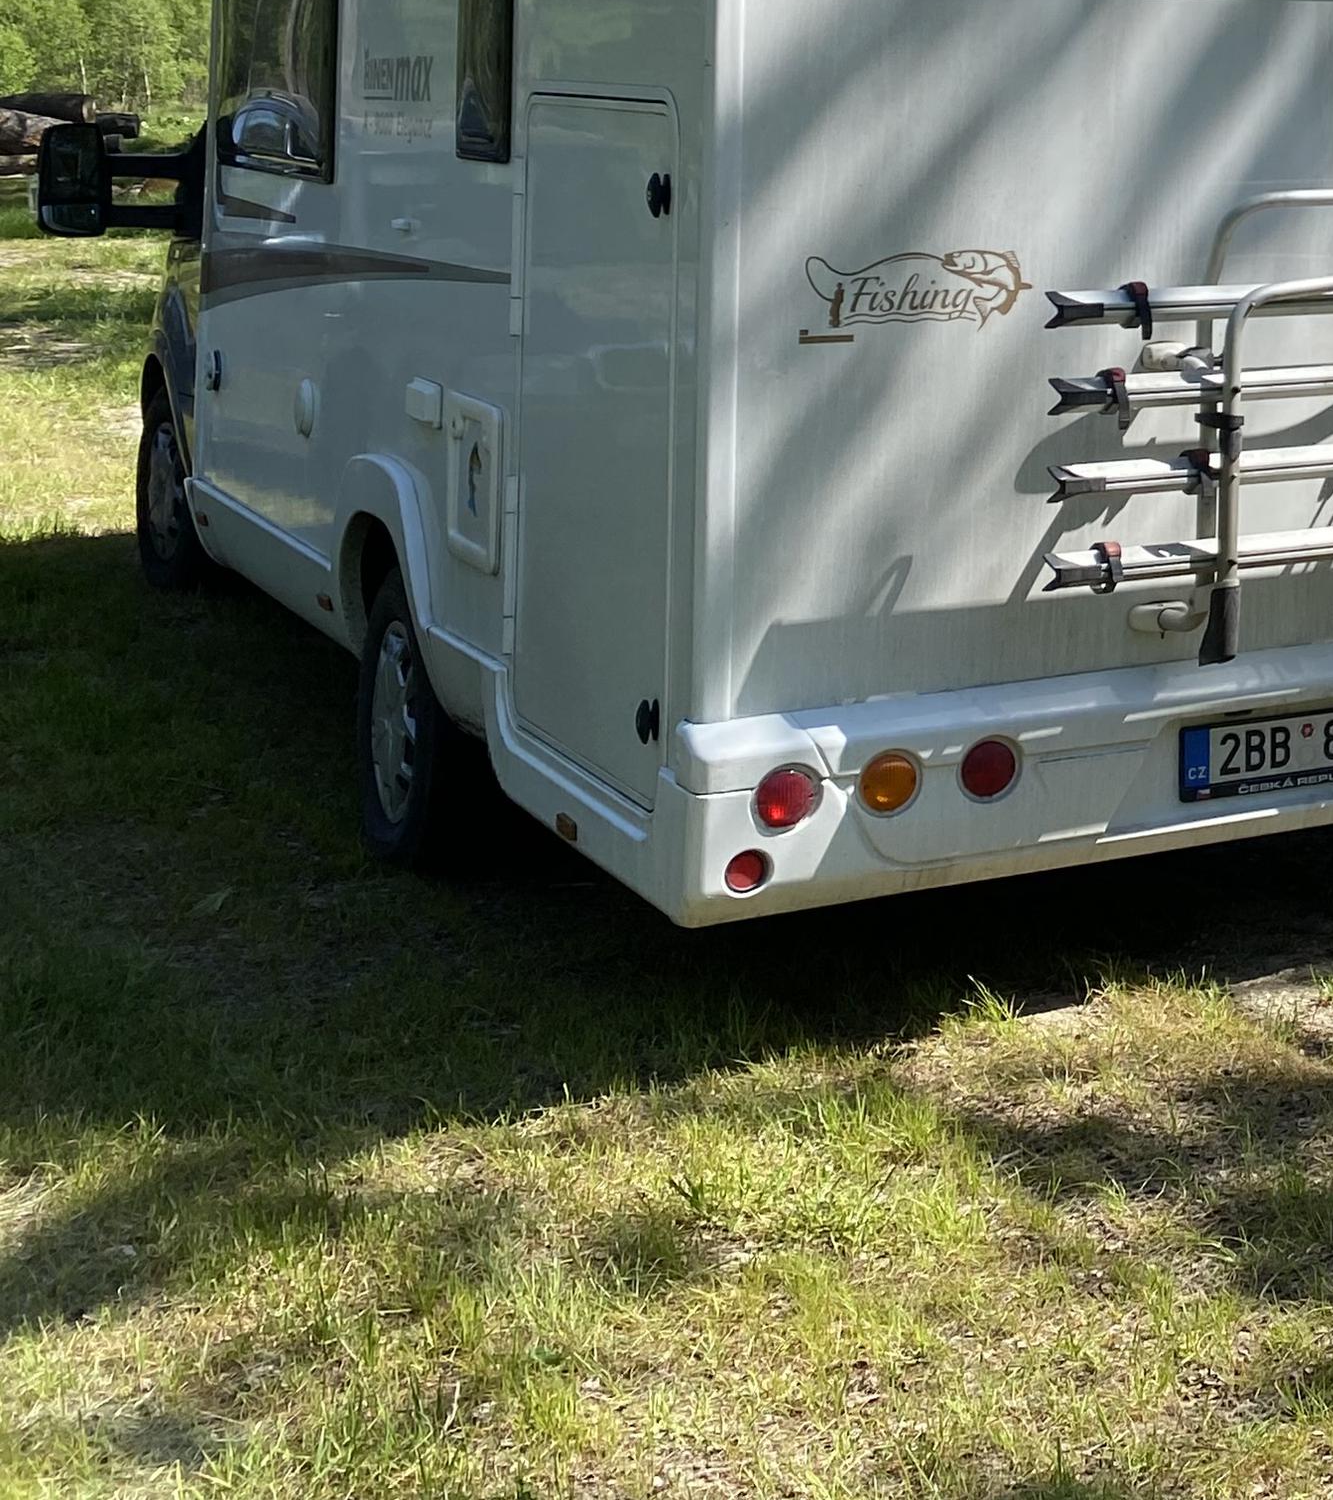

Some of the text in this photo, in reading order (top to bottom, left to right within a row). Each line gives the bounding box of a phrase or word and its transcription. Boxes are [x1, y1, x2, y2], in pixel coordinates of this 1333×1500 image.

[849, 273, 977, 320] Fishing
[1188, 766, 1207, 780] CZ
[1219, 726, 1291, 777] 2BB
